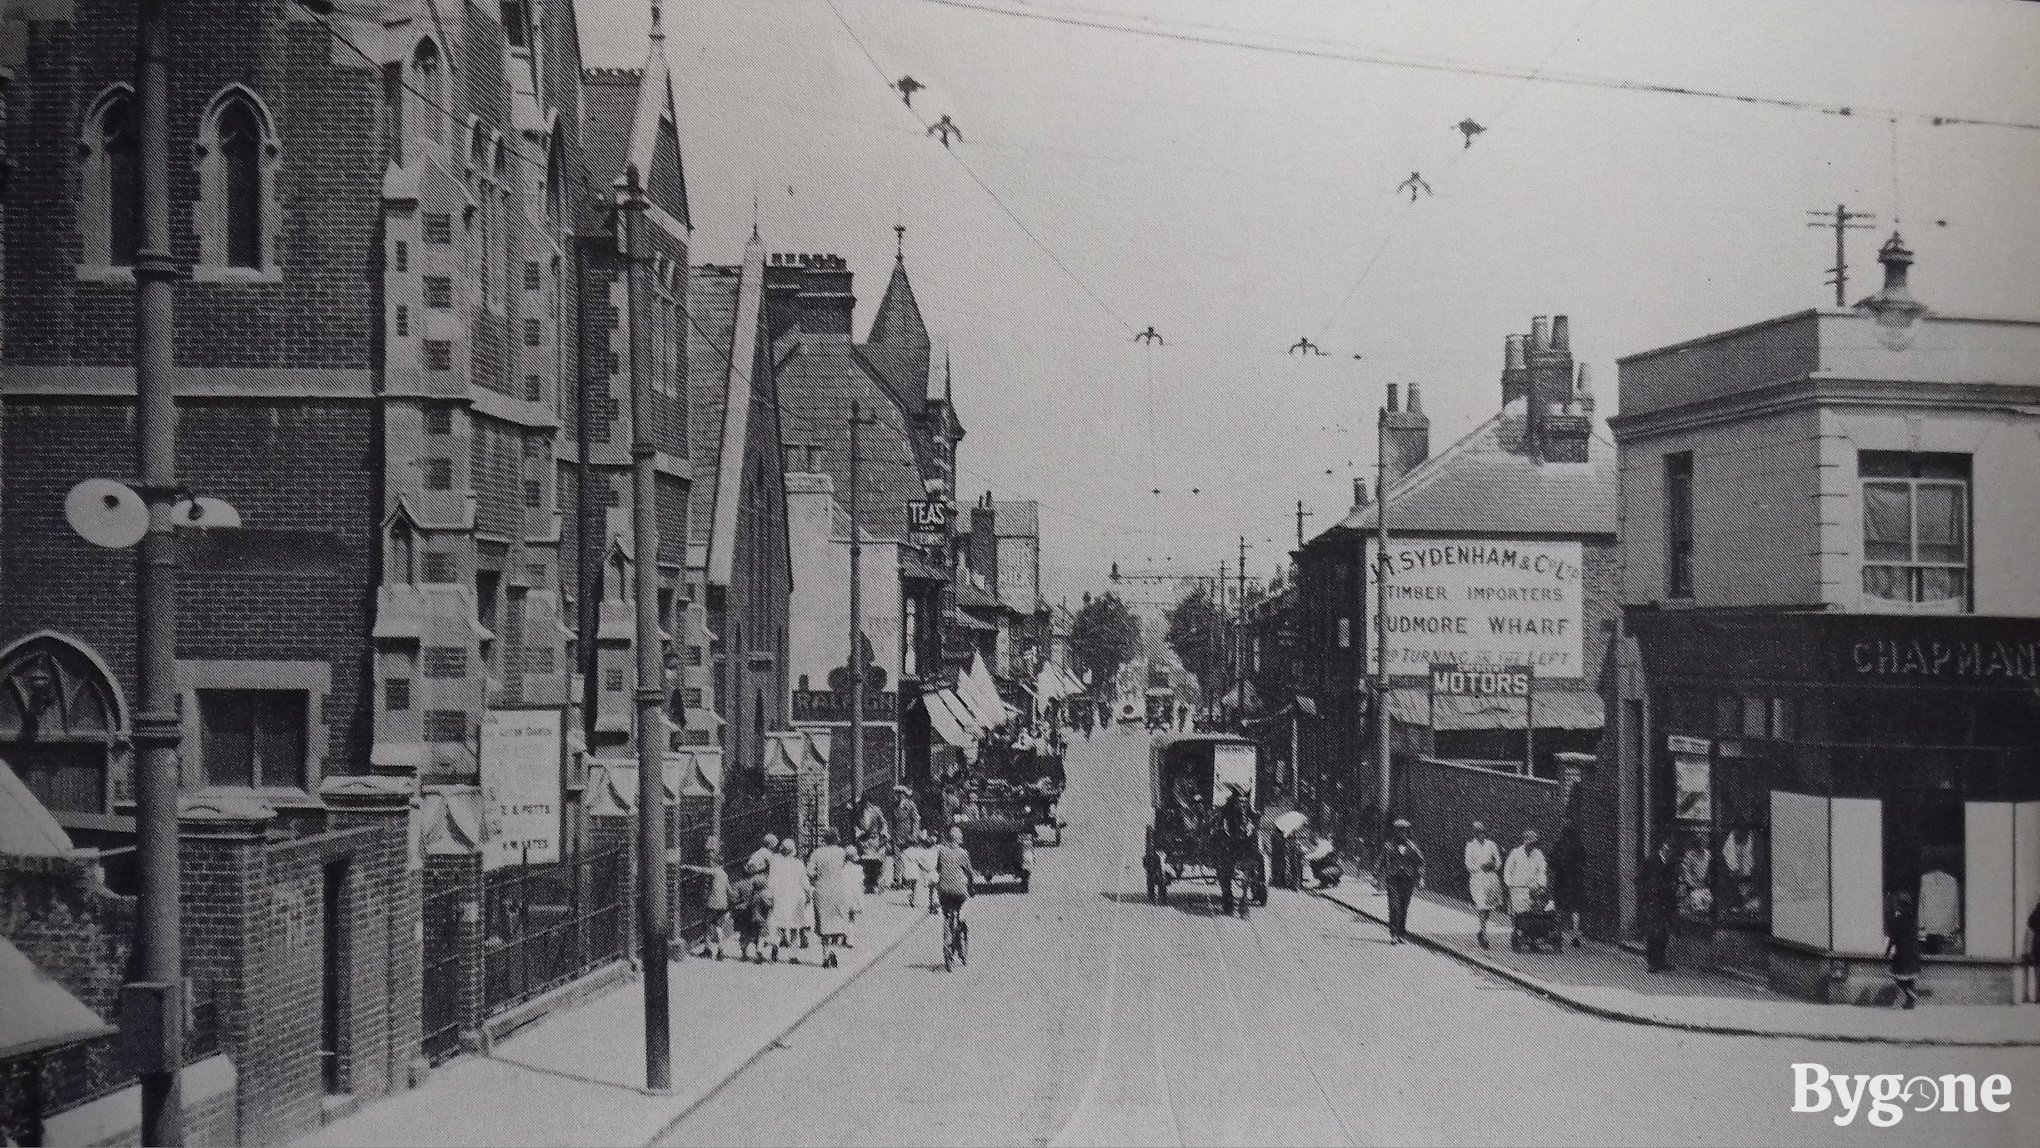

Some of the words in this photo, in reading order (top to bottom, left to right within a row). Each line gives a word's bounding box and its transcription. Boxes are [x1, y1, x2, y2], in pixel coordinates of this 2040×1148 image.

[909, 502, 945, 524] TEAS
[1400, 546, 1516, 571] SYDENHAM
[1519, 555, 1530, 571] &
[1386, 585, 1447, 600] TIMBER
[1467, 587, 1564, 601] IMPORTERS
[1488, 617, 1569, 635] WHARF
[1527, 650, 1571, 666] LEFT
[1853, 639, 2038, 677] CHAPMAN
[1433, 672, 1528, 694] MOTORS
